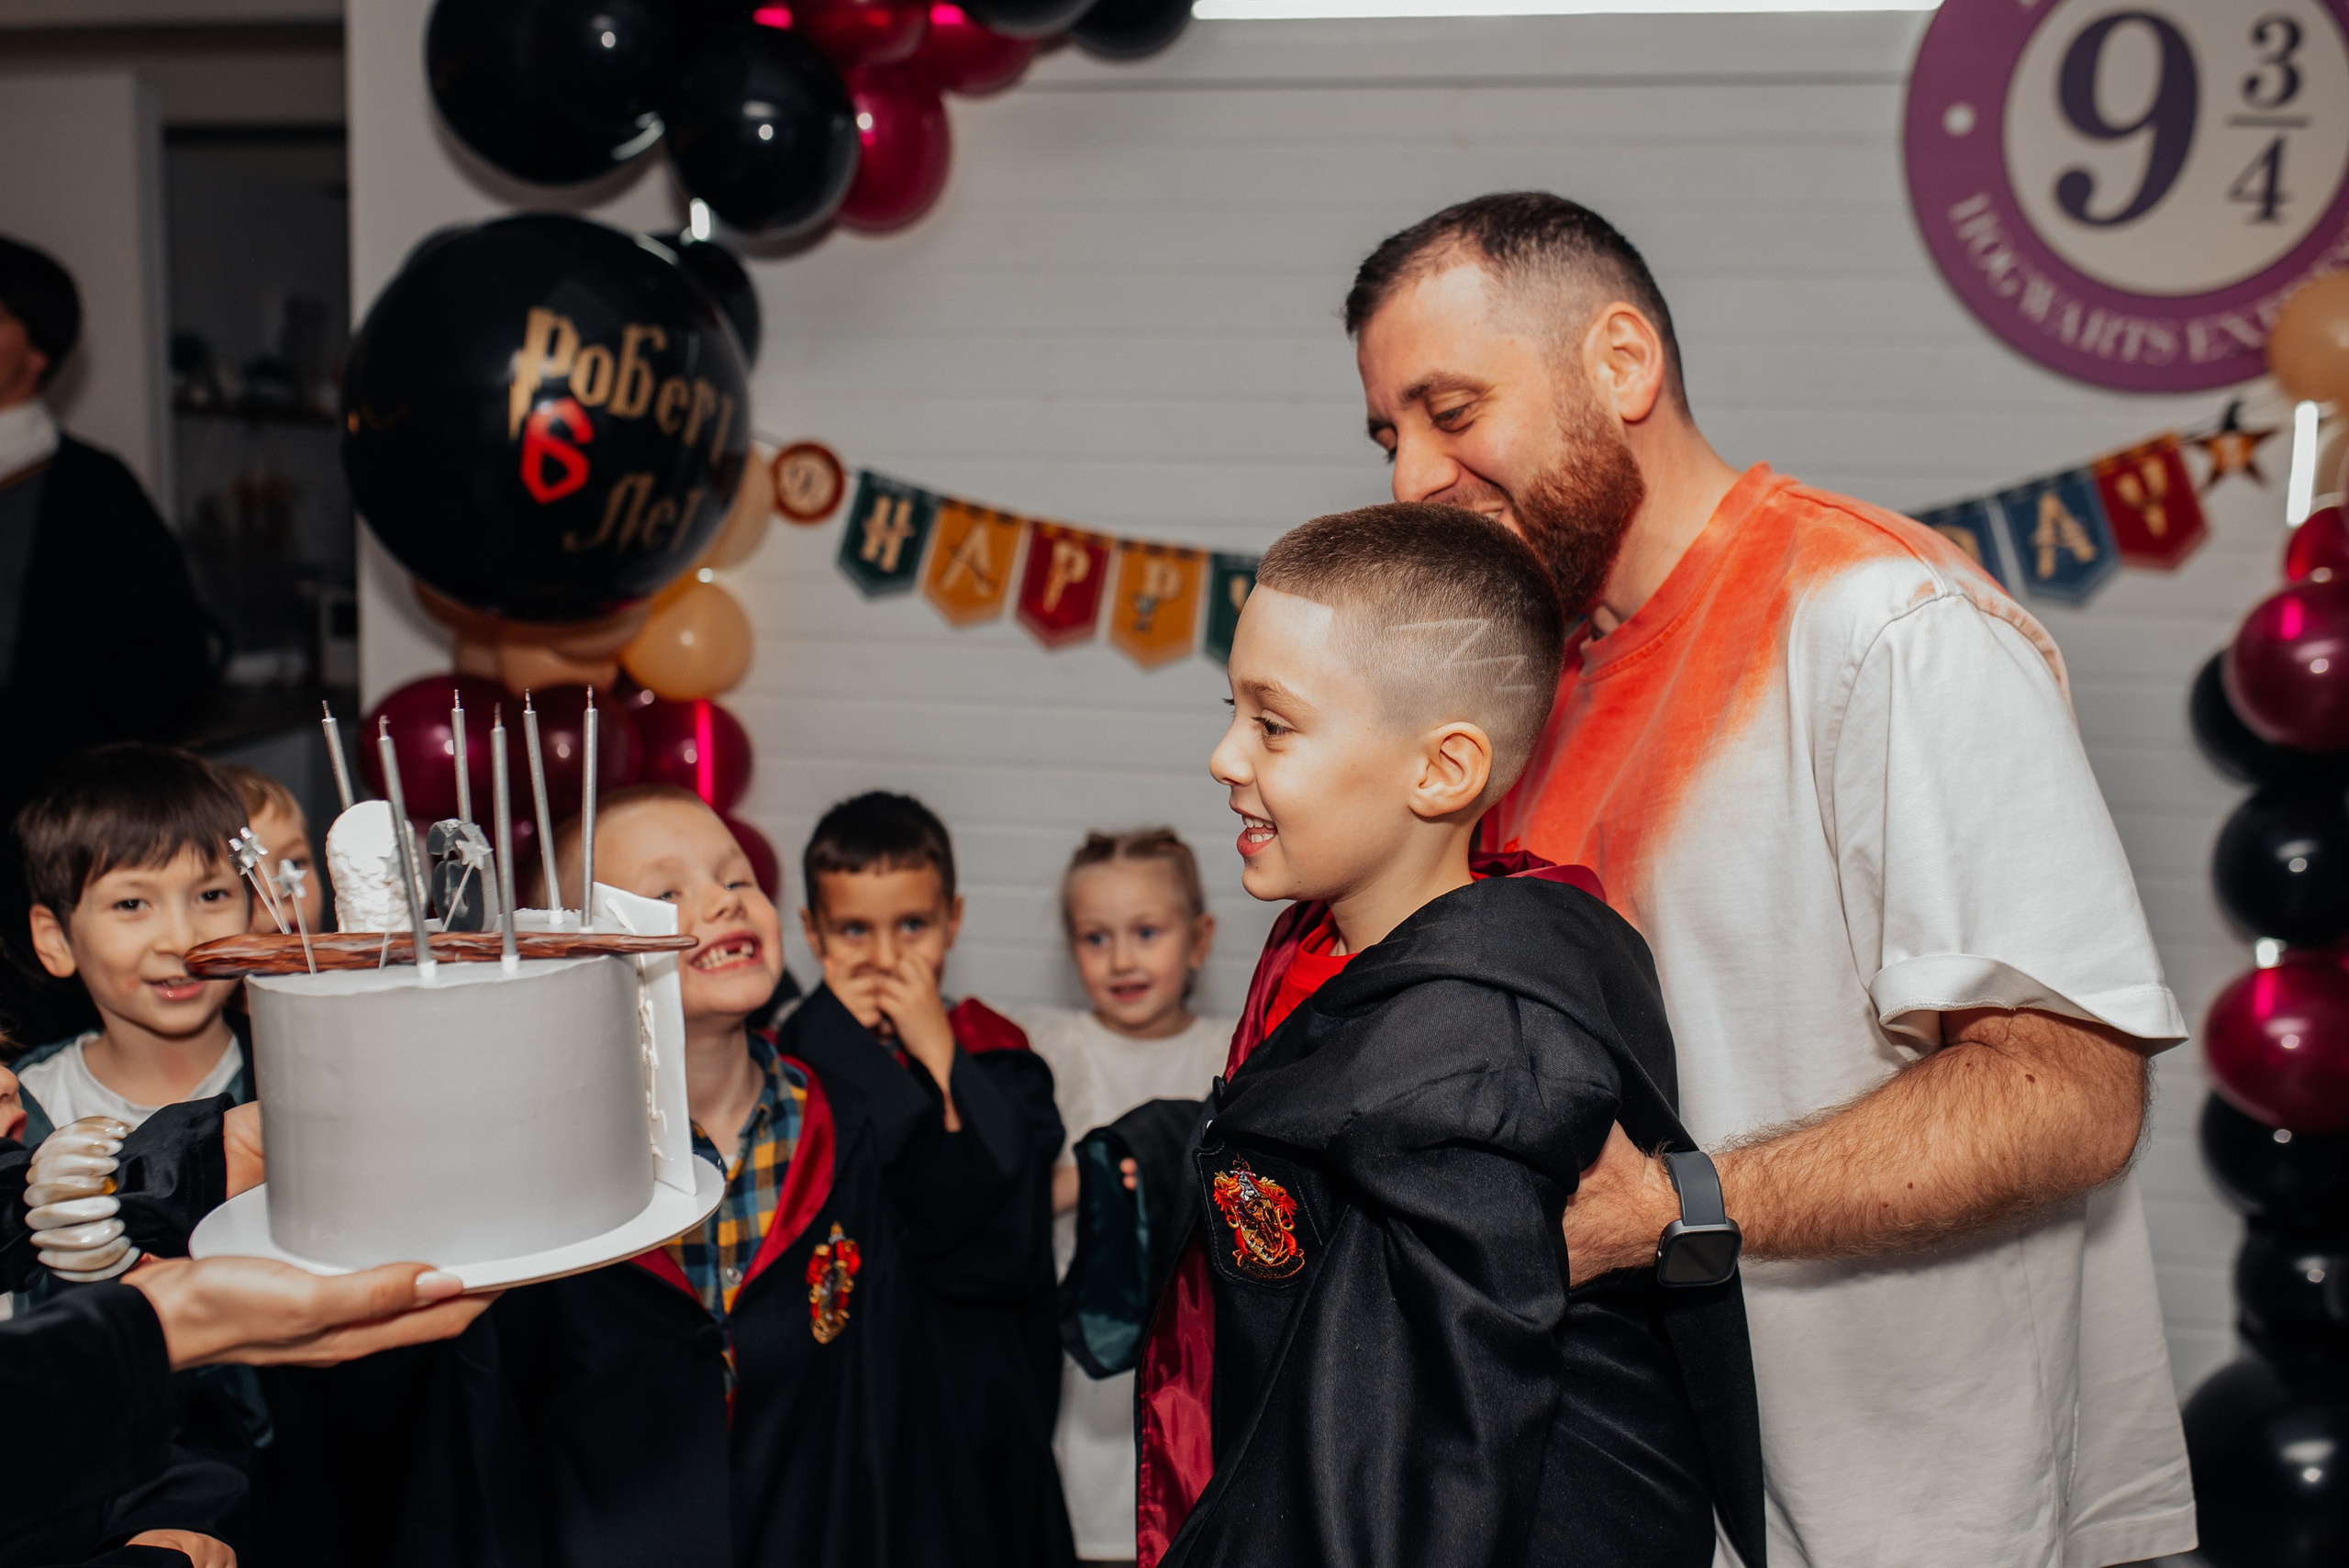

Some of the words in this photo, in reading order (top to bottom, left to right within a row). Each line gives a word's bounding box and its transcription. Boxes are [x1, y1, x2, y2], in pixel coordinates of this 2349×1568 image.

[2054, 10, 2200, 230] 9
[1946, 192, 2180, 365] HOGWARTS
[519, 395, 596, 506] 6
